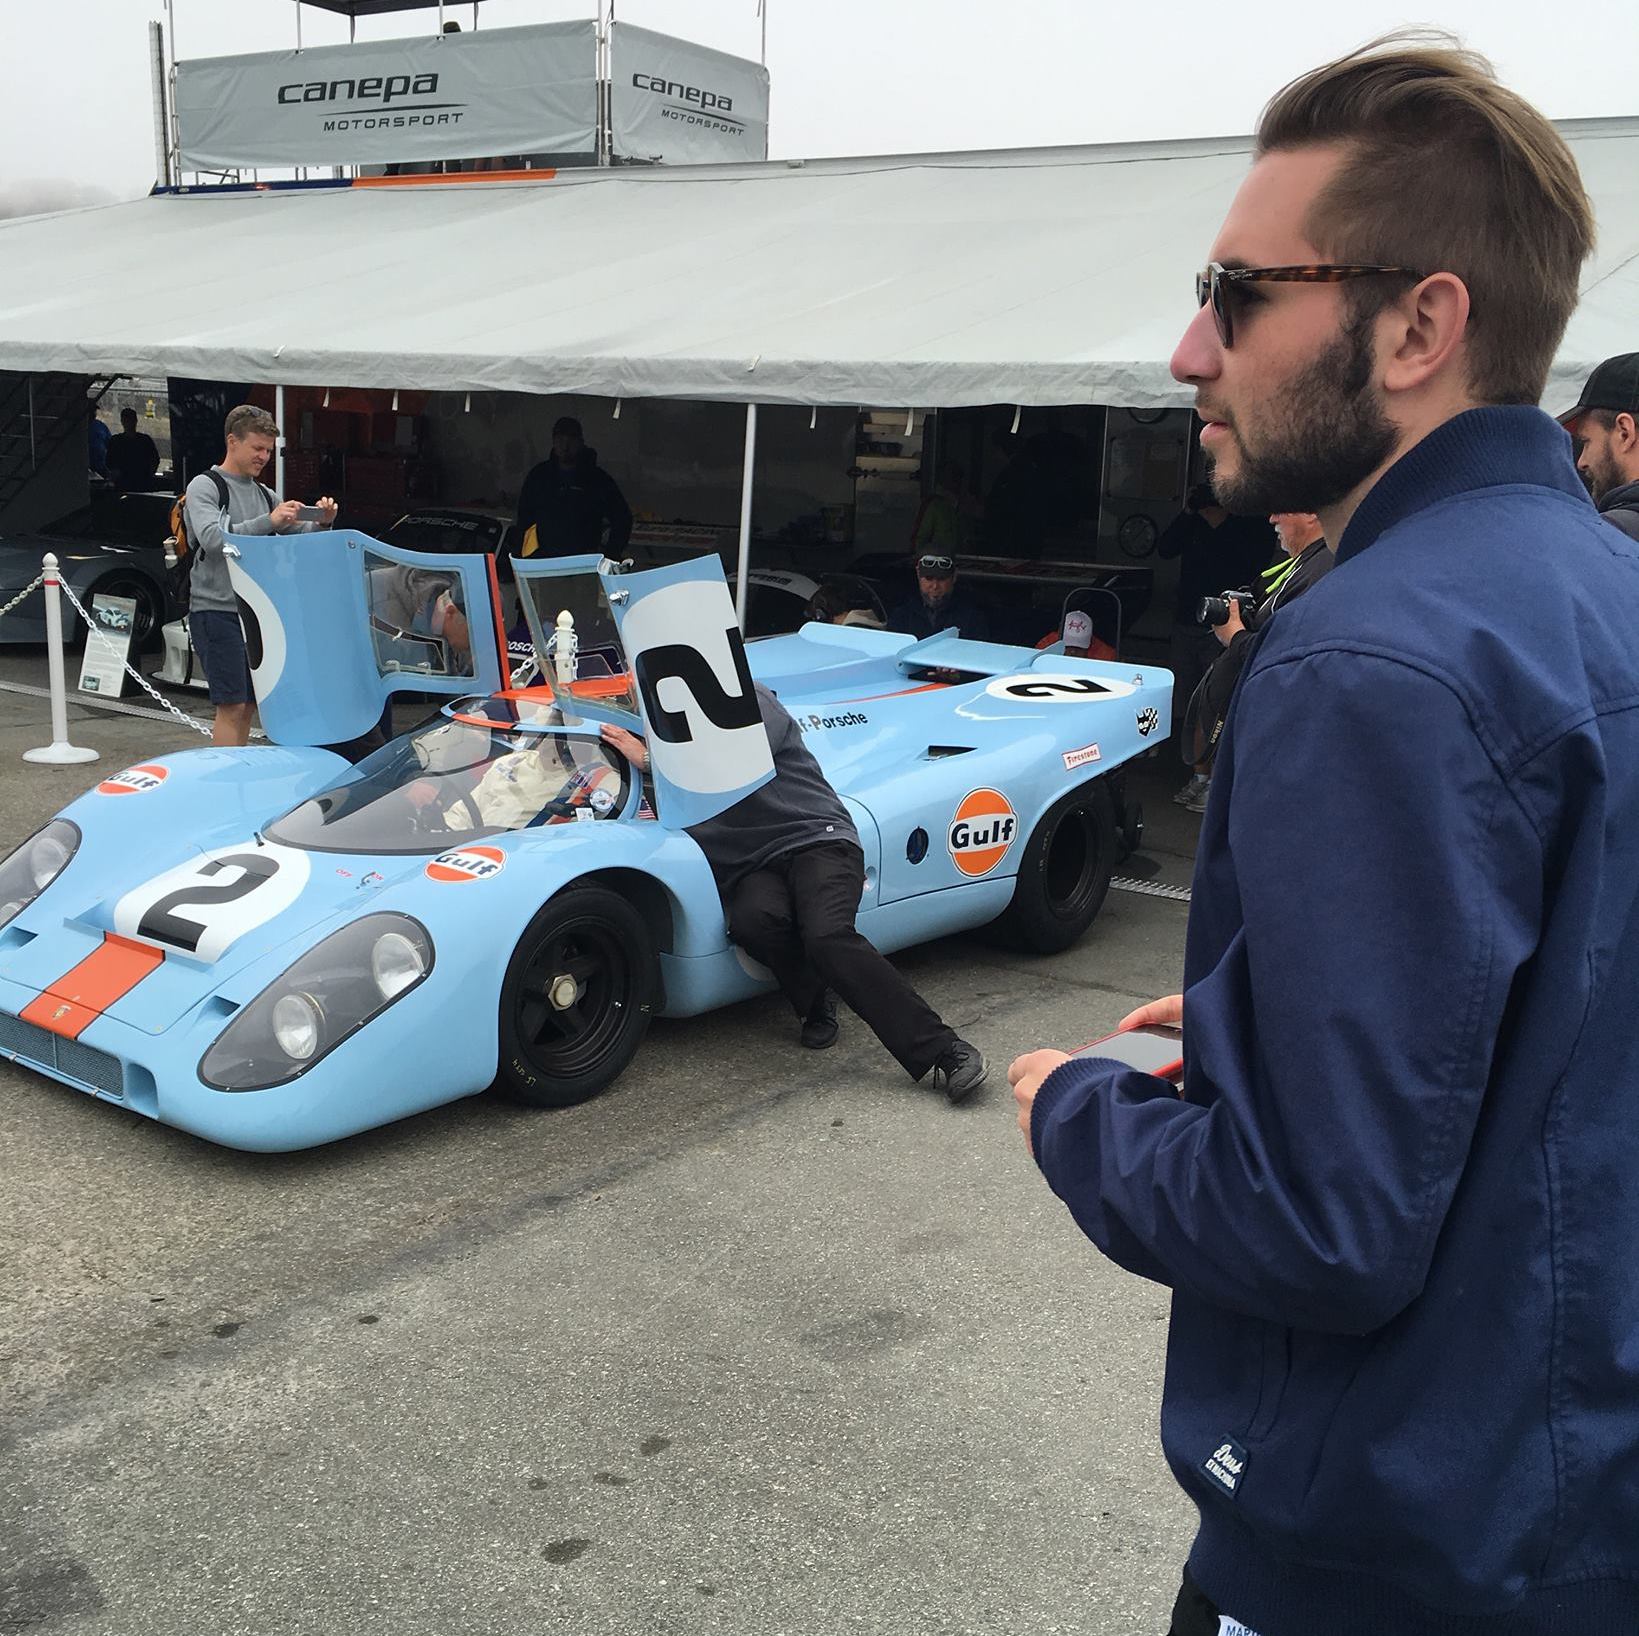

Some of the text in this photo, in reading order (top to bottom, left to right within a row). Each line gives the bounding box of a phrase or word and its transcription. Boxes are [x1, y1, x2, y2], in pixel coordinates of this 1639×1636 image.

[277, 73, 439, 104] canepa
[632, 73, 733, 112] canepa
[323, 112, 464, 132] MOTORSPORT
[661, 109, 744, 137] MOTORSPORT
[635, 626, 764, 743] 2
[1005, 679, 1112, 697] 2
[1210, 719, 1224, 744] Nikon
[1066, 748, 1098, 766] Firestone
[107, 771, 160, 788] Gulf
[951, 818, 1014, 849] Gulf
[434, 853, 498, 875] Gulf
[136, 853, 281, 953] 2
[1213, 1444, 1244, 1474] Deus
